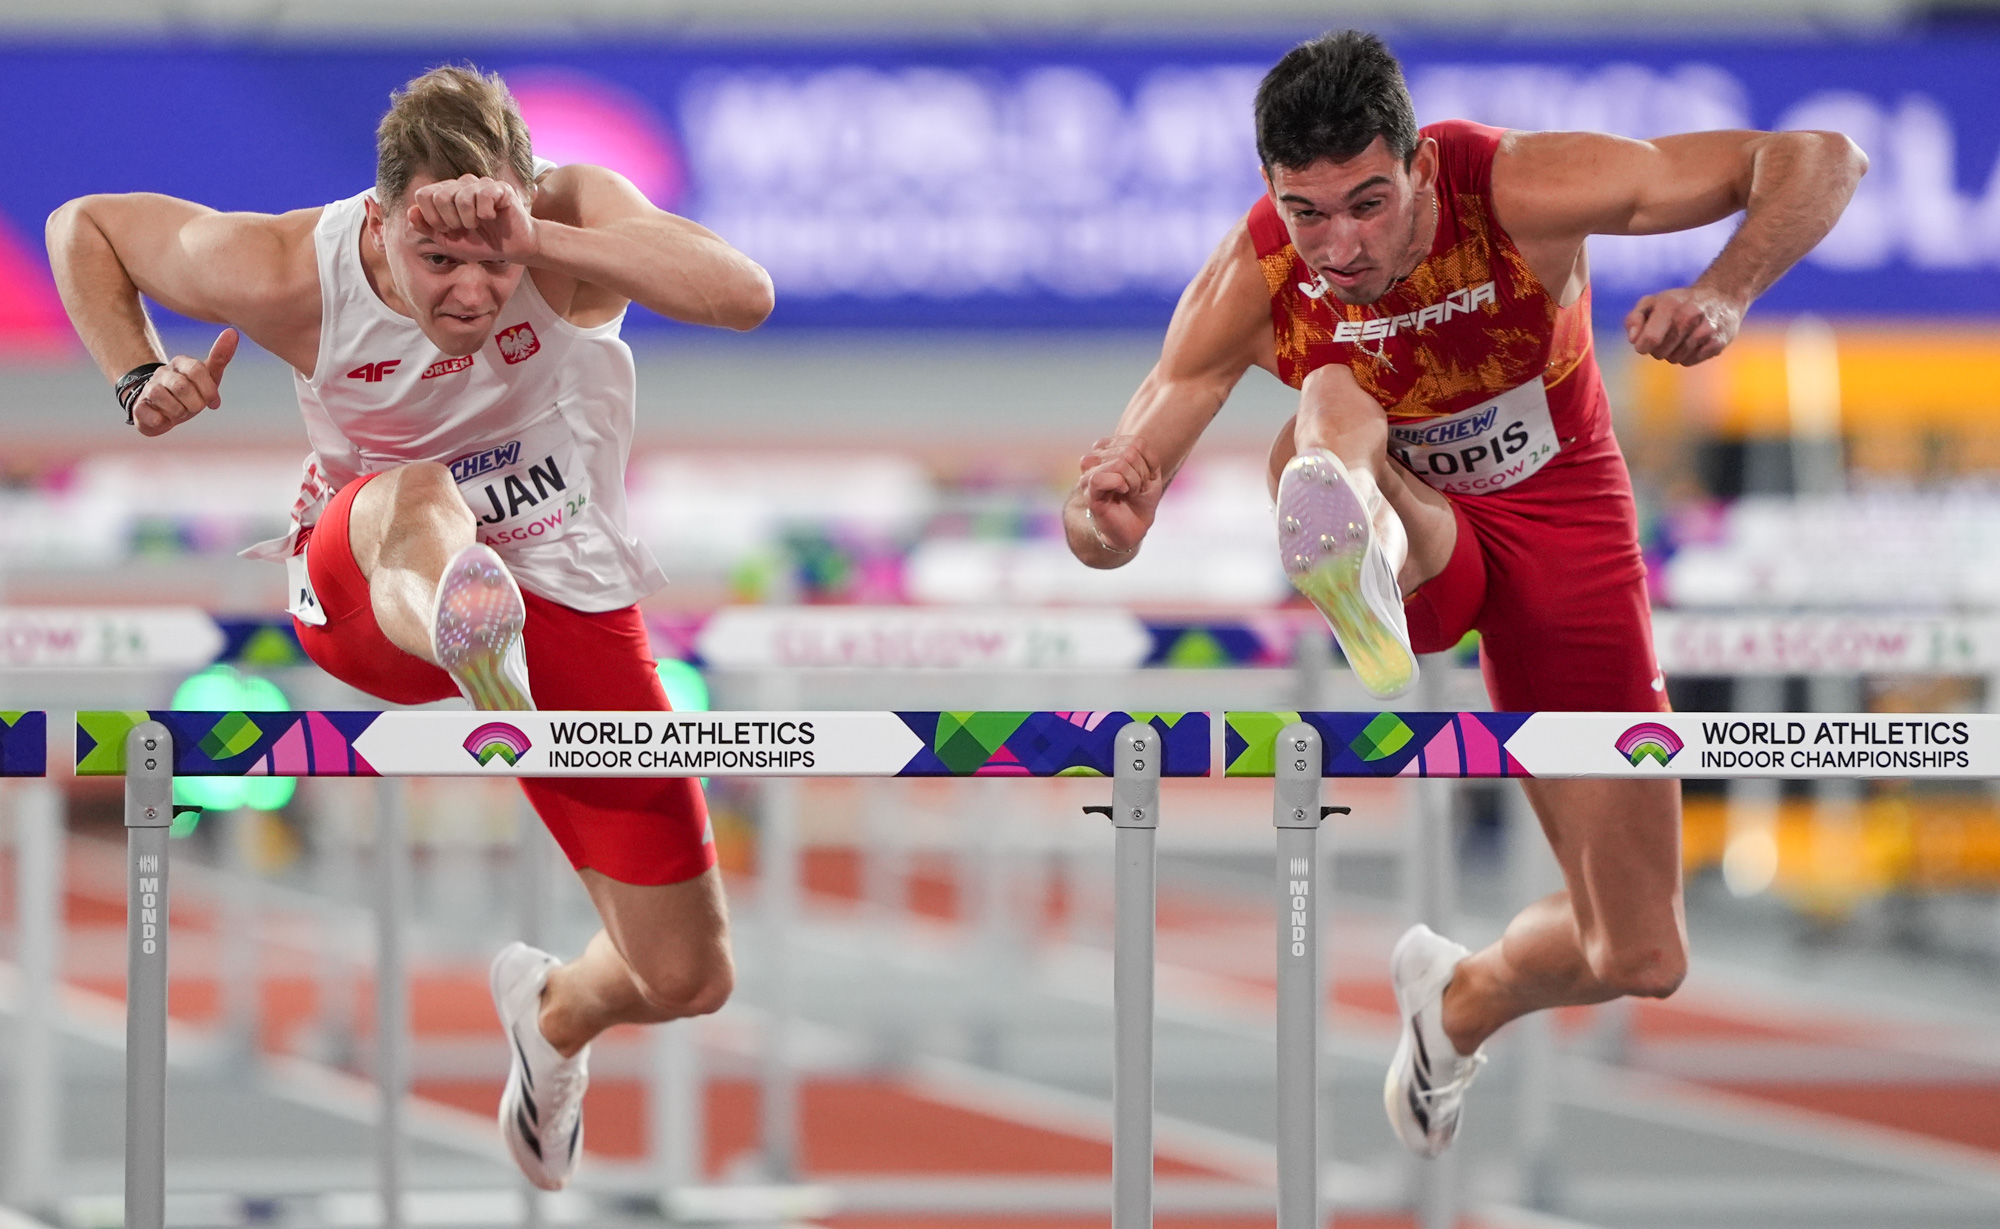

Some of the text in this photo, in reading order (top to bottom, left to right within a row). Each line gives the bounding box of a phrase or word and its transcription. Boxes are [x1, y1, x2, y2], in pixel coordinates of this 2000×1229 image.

[347, 360, 401, 383] 4F
[423, 356, 471, 379] ORLEN
[1391, 406, 1498, 446] HI-CHEW
[450, 440, 521, 484] CHEW
[1443, 442, 1551, 493] ASGOW 24
[476, 455, 567, 527] JAN
[484, 493, 587, 546] ASGOW 24
[550, 722, 815, 744] WORLD ATHLETICS
[1702, 722, 1969, 744] WORLD ATHLETICS
[549, 751, 815, 768] INDOOR CHAMPIONSHIPS
[1701, 751, 1969, 768] INDOOR CHAMPIONSHIPS
[139, 877, 159, 954] MONDO
[1289, 880, 1309, 957] MONDO
